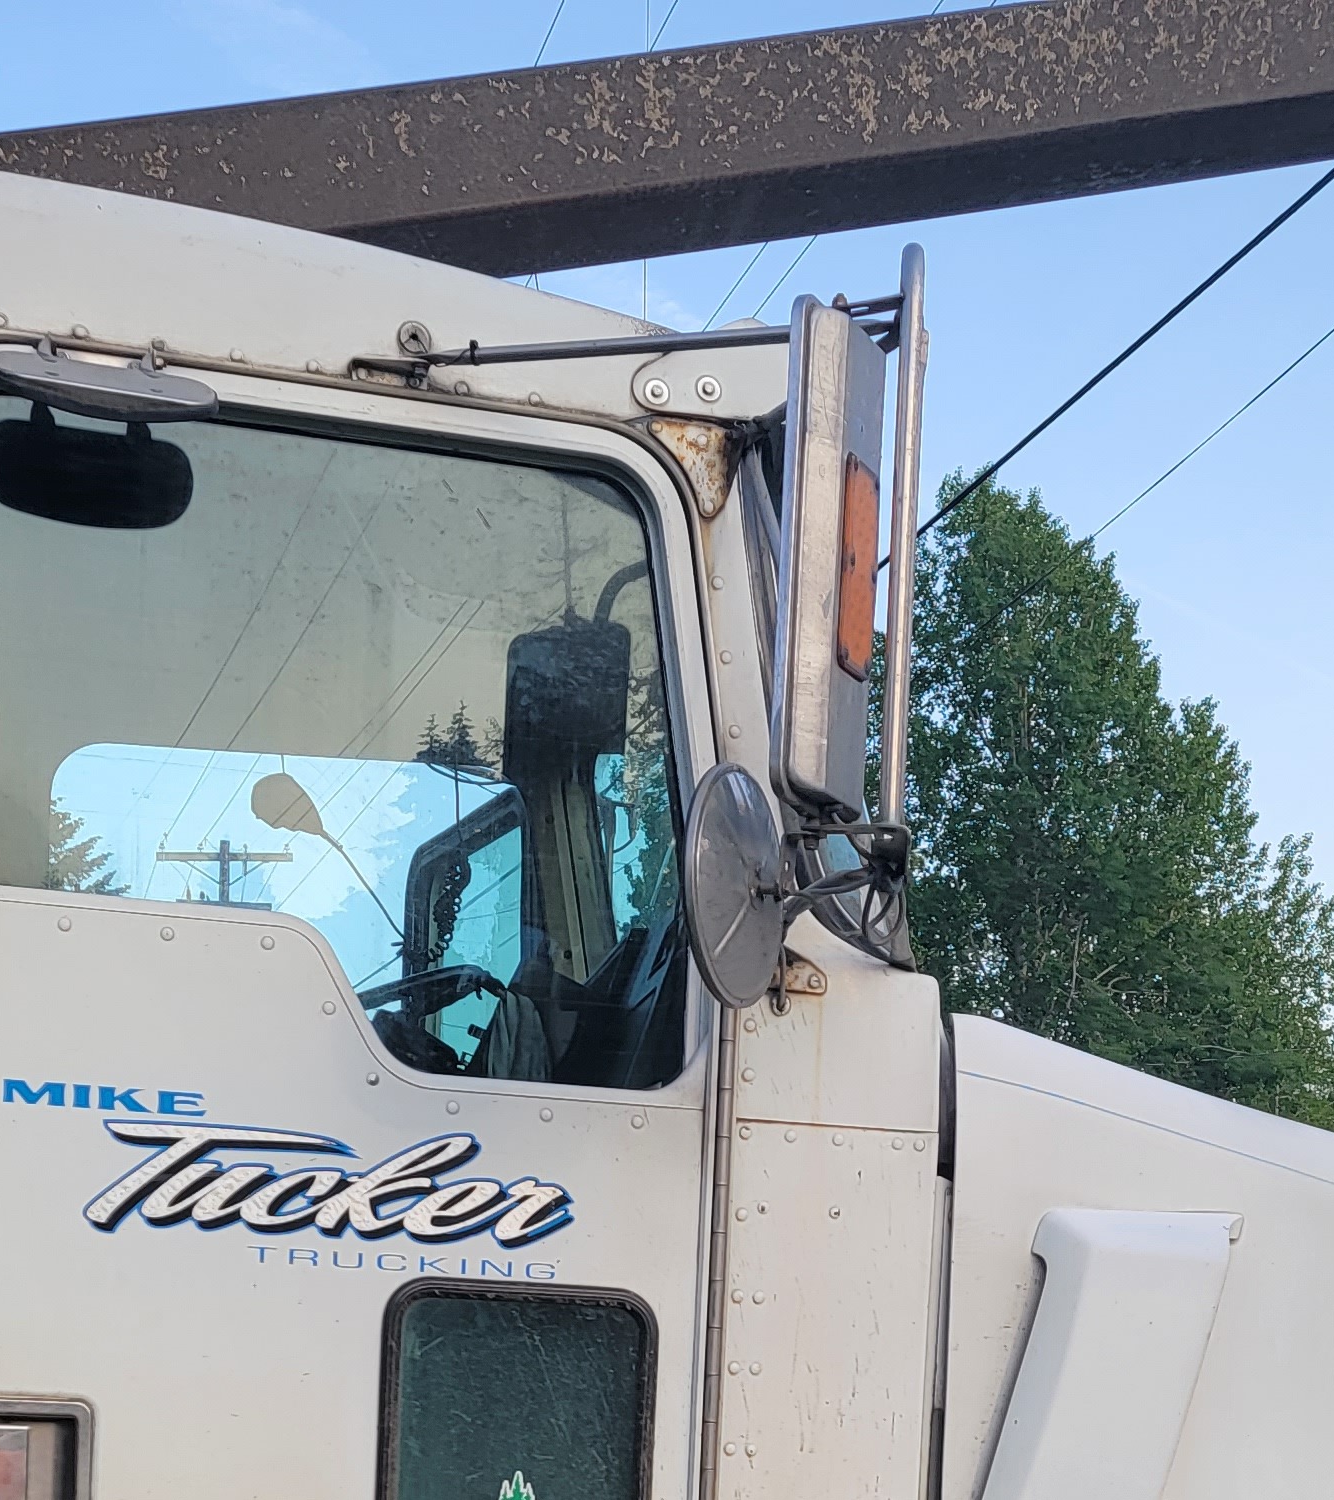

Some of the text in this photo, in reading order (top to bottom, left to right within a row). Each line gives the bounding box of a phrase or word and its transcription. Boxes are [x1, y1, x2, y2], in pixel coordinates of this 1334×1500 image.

[2, 1077, 208, 1117] MIKE
[82, 1118, 576, 1250] Tucker
[246, 1244, 558, 1280] TRUCKING
